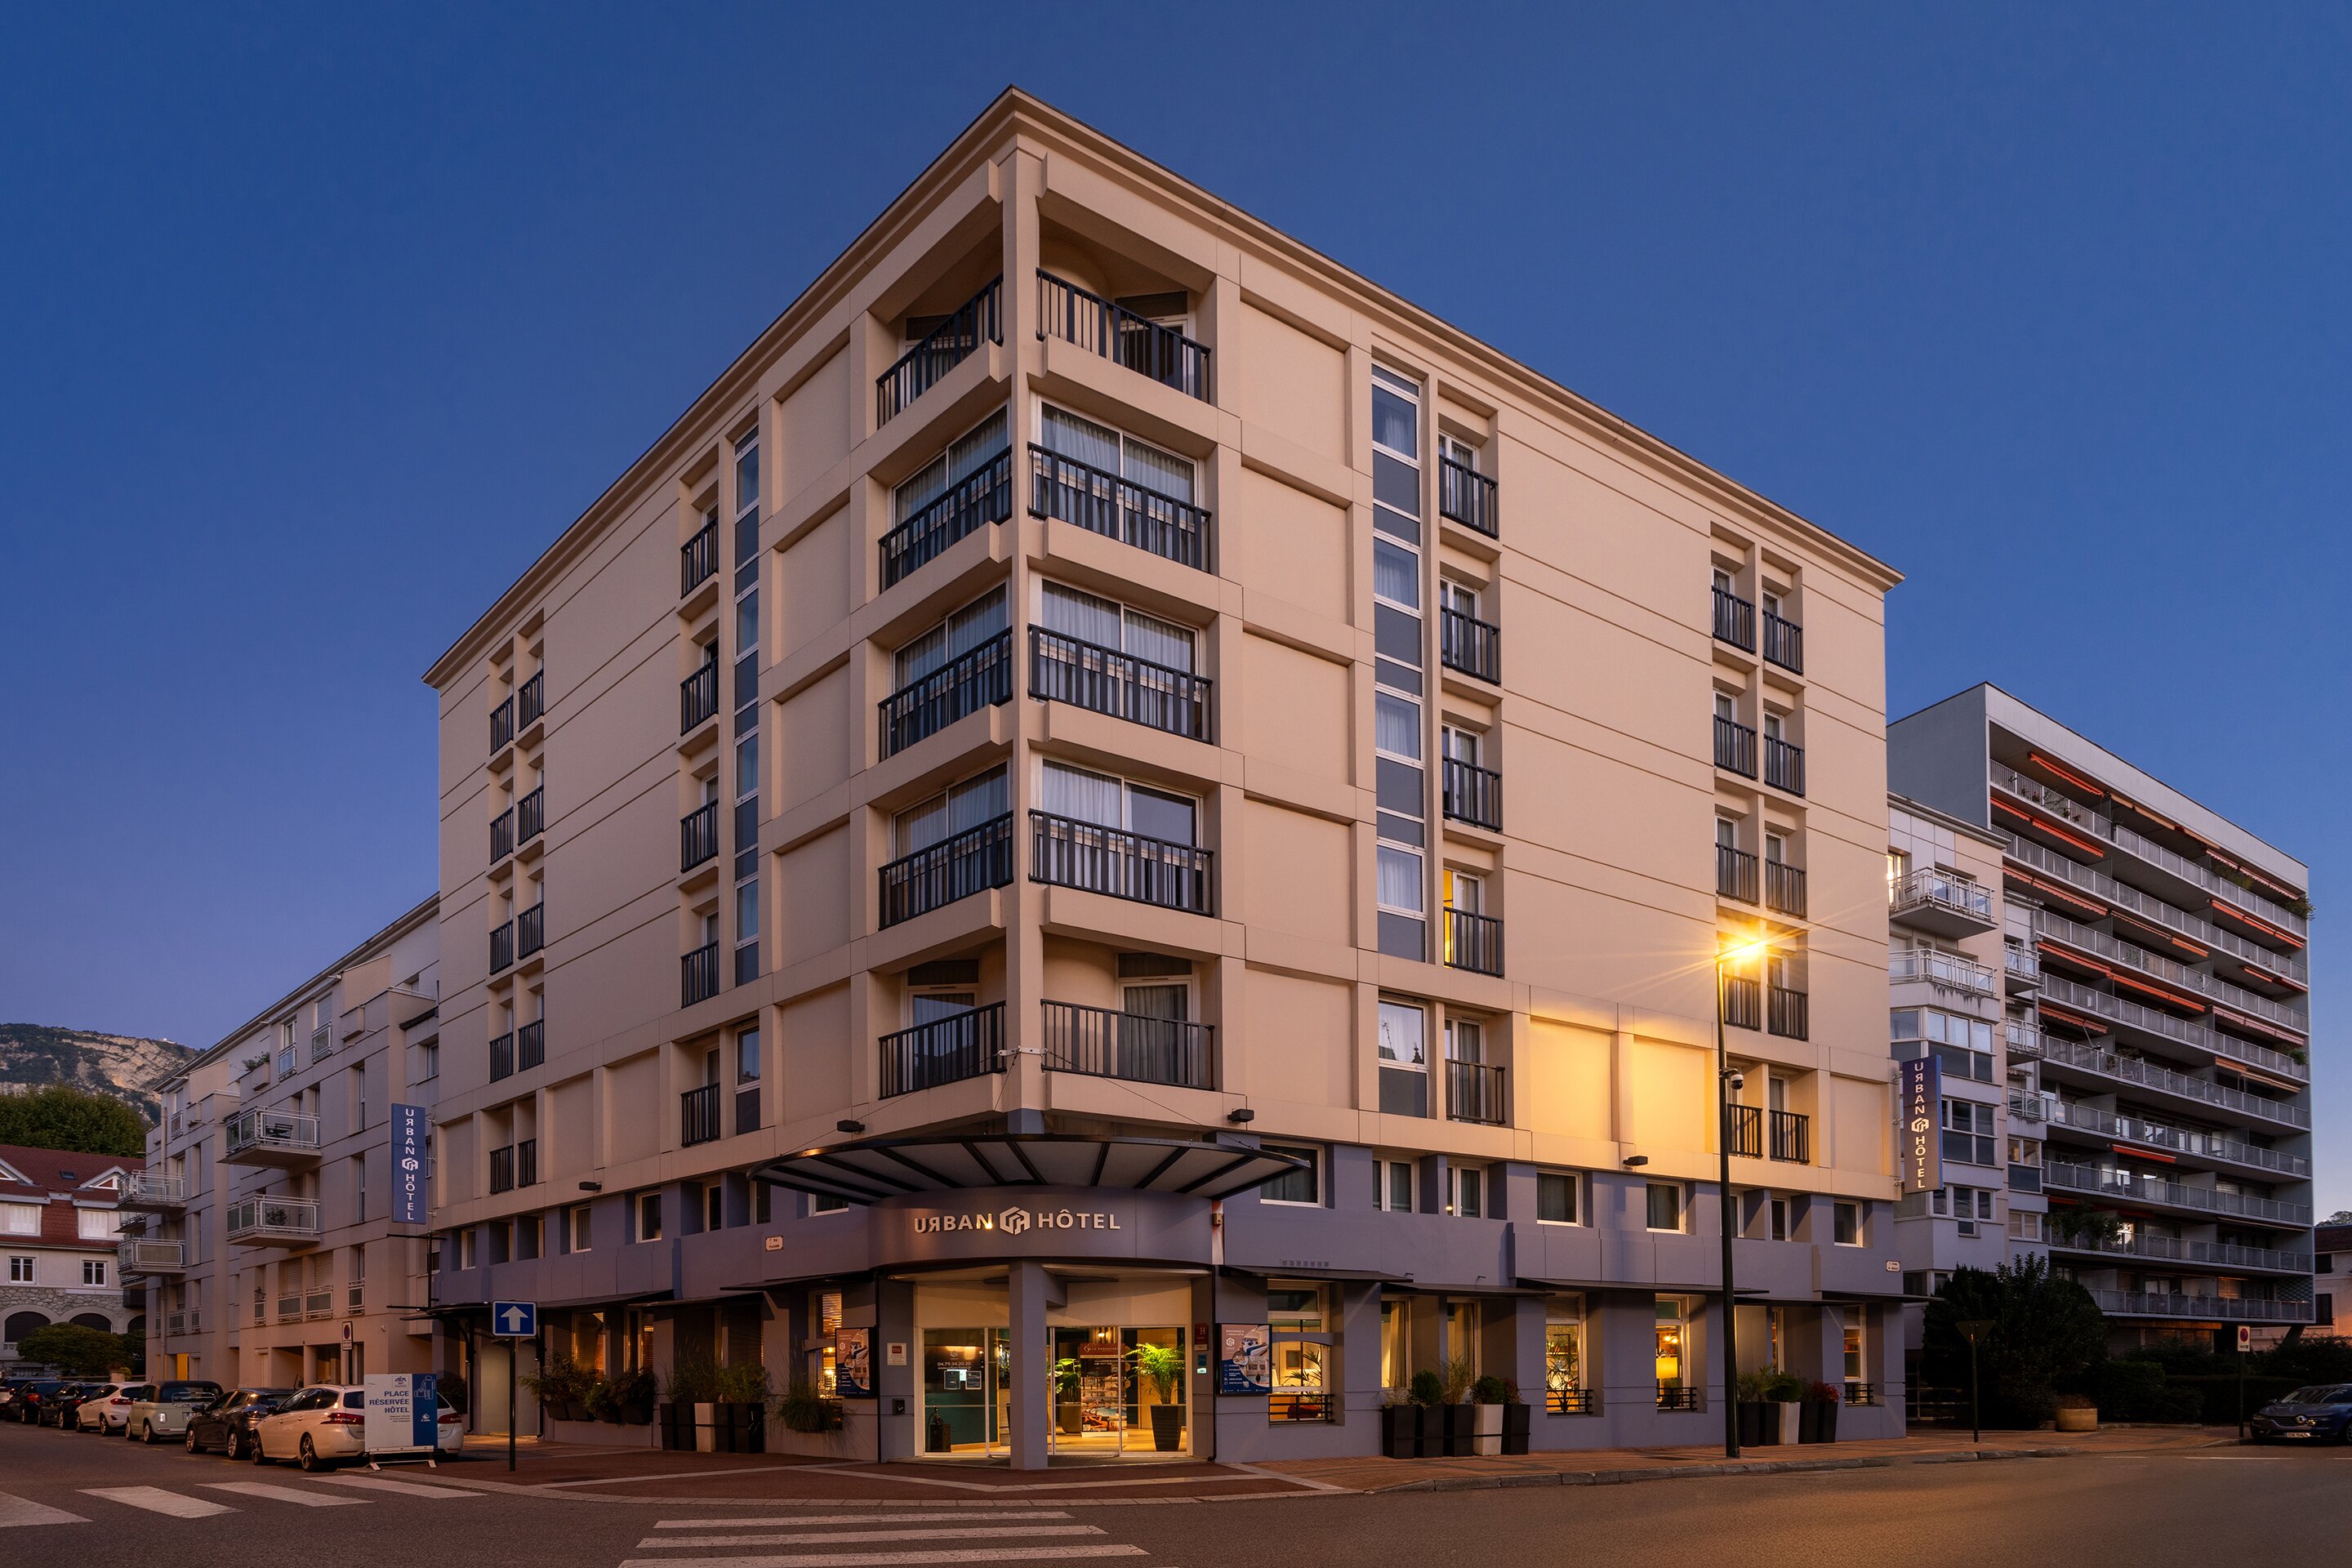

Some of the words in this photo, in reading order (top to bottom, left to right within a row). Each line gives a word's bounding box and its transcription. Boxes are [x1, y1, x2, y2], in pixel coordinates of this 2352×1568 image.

[1914, 1062, 1925, 1116] URBAN
[405, 1108, 415, 1156] URBAN
[1915, 1135, 1926, 1188] HÔTEL
[405, 1174, 415, 1220] HÔTEL
[914, 1213, 993, 1233] URBAN
[1038, 1209, 1120, 1230] HÔTEL
[369, 1397, 409, 1405] RÉSERVÉE
[385, 1405, 409, 1414] HÔTEL
